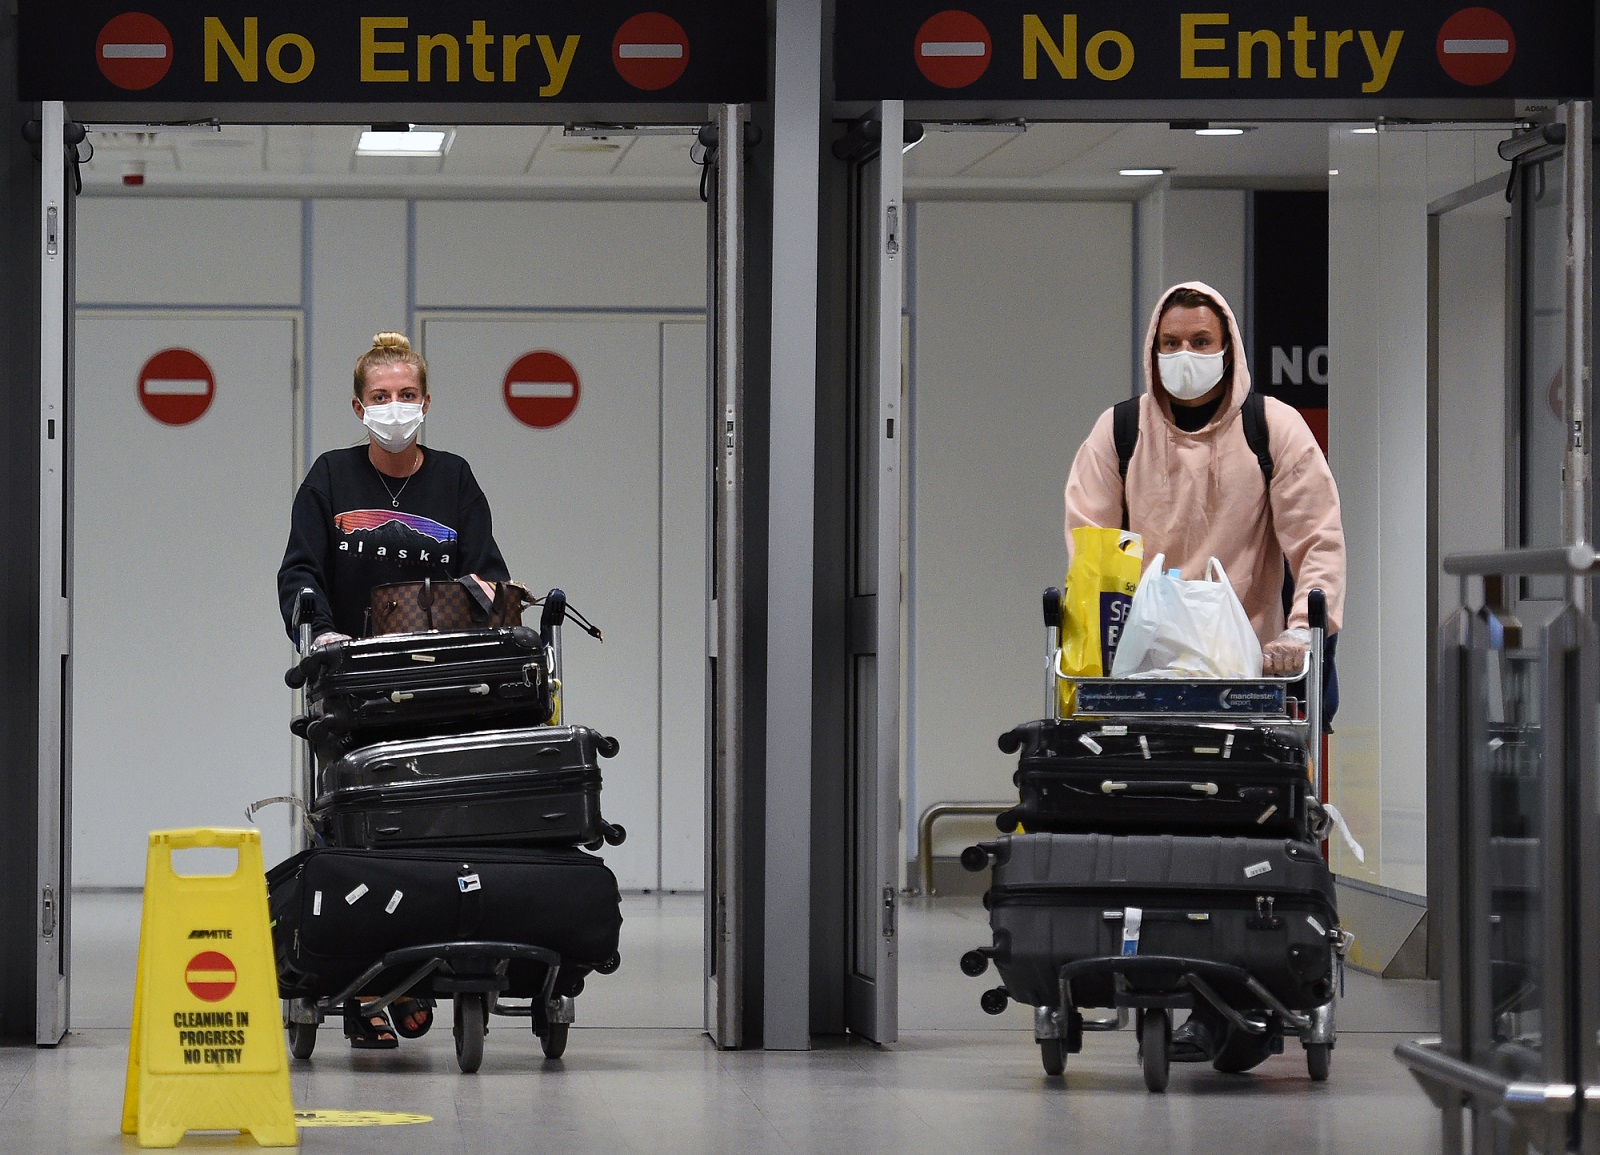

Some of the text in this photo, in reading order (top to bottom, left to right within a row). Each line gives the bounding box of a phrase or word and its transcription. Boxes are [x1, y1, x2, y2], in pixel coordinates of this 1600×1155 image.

[204, 16, 580, 97] No Entry
[1022, 12, 1404, 93] No Entry
[339, 541, 450, 564] alaska
[173, 1011, 249, 1028] CLEANING IN
[179, 1030, 246, 1047] PROGRESS
[184, 1048, 242, 1065] NO ENTRY
